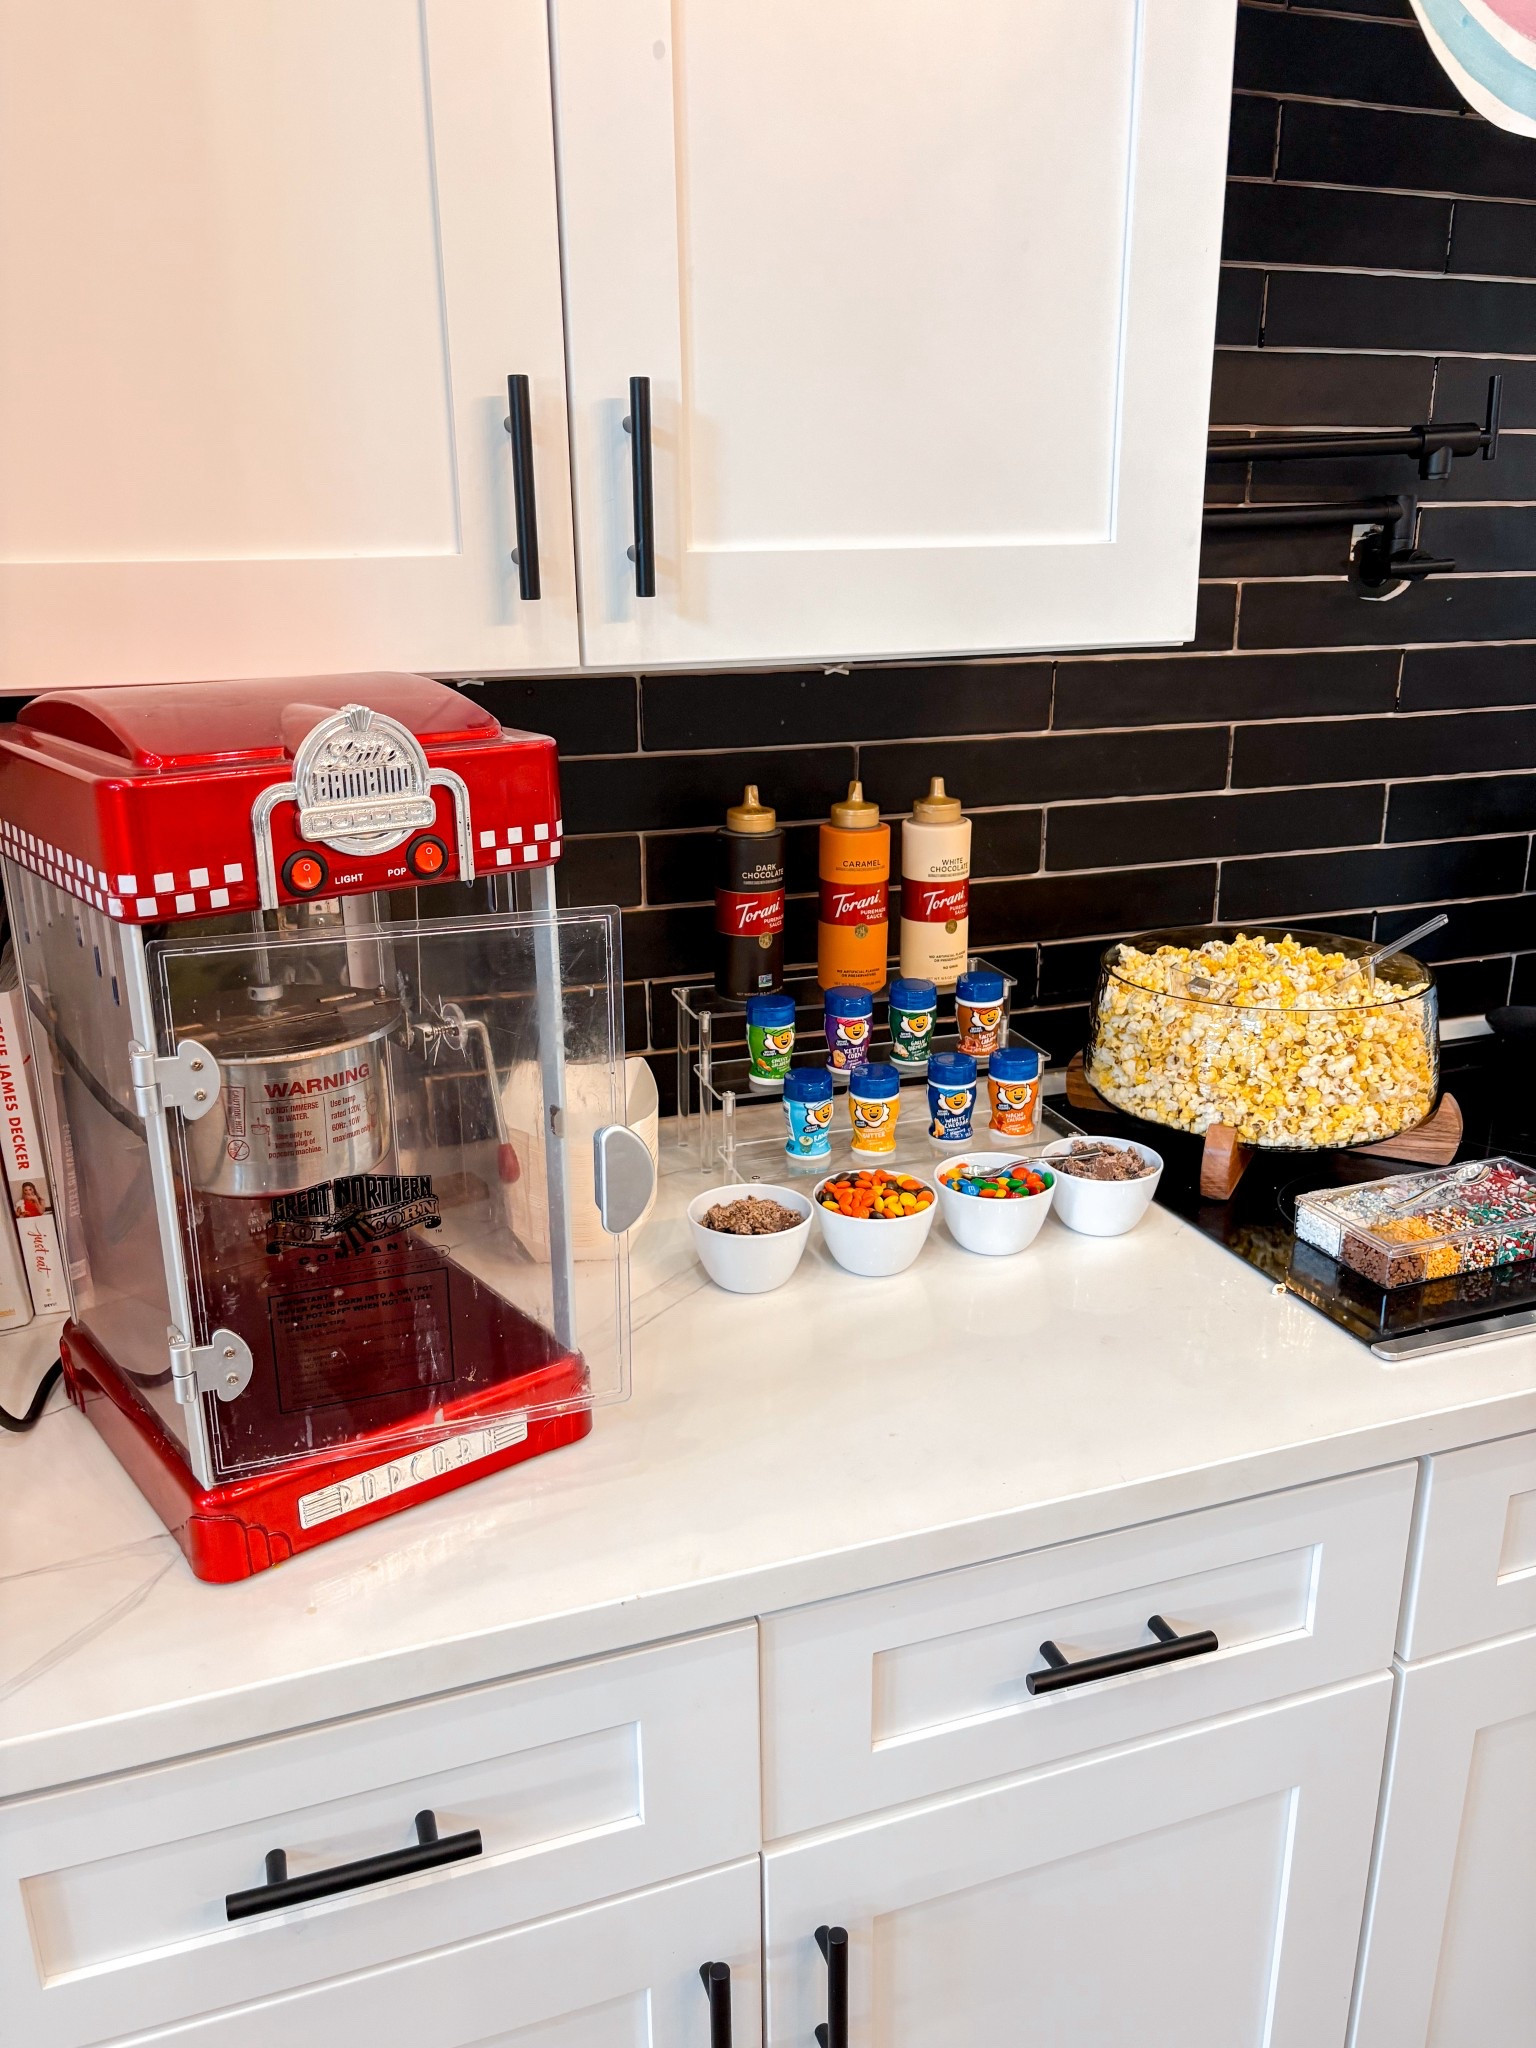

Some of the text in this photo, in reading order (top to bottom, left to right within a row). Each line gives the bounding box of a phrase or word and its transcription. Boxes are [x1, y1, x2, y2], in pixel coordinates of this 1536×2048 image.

[313, 766, 412, 800] BAMBINO
[755, 863, 777, 872] DARK
[842, 860, 881, 868] CARAMEL
[929, 862, 969, 873] CHOCOLATE
[941, 857, 964, 866] WHITE
[387, 867, 407, 877] POP
[741, 867, 784, 879] CHOCOLATE
[334, 873, 364, 885] LIGHT
[832, 889, 881, 918] Torani
[923, 886, 965, 916] Torani
[735, 897, 780, 929] Torani
[769, 921, 782, 929] SAUCE
[843, 1045, 865, 1055] KETTLE
[264, 1063, 370, 1098] WARNING
[330, 1095, 356, 1108] Use lamp
[265, 1101, 319, 1115] DO NOT IMMERSE
[0, 1064, 30, 1170] JAMES DECKER
[286, 1112, 310, 1122] WATER.
[331, 1110, 347, 1120] rated
[944, 1115, 966, 1124] WHITE
[944, 1118, 969, 1129] CHEDDAR
[289, 1131, 303, 1139] only
[304, 1129, 313, 1137] for
[332, 1122, 372, 1144] maximum only
[294, 1139, 309, 1148] plug
[309, 1137, 316, 1145] of
[268, 1149, 295, 1160] popcorn
[271, 1173, 432, 1219] GREAT NORTHERN
[274, 1199, 437, 1243] POP CORN
[27, 1223, 52, 1279] just eat
[298, 1239, 413, 1265] COMPANY
[277, 1306, 308, 1317] NEVER
[310, 1301, 335, 1310] POUR
[337, 1297, 363, 1307] CORN
[365, 1292, 386, 1301] INTO
[397, 1287, 414, 1296] DRY
[277, 1314, 304, 1324] TURN
[306, 1311, 323, 1321] POT
[353, 1302, 379, 1312] WHEN
[381, 1298, 399, 1307] NOT
[285, 1322, 328, 1334] OPERATING
[338, 1428, 496, 1513] POPCORN
